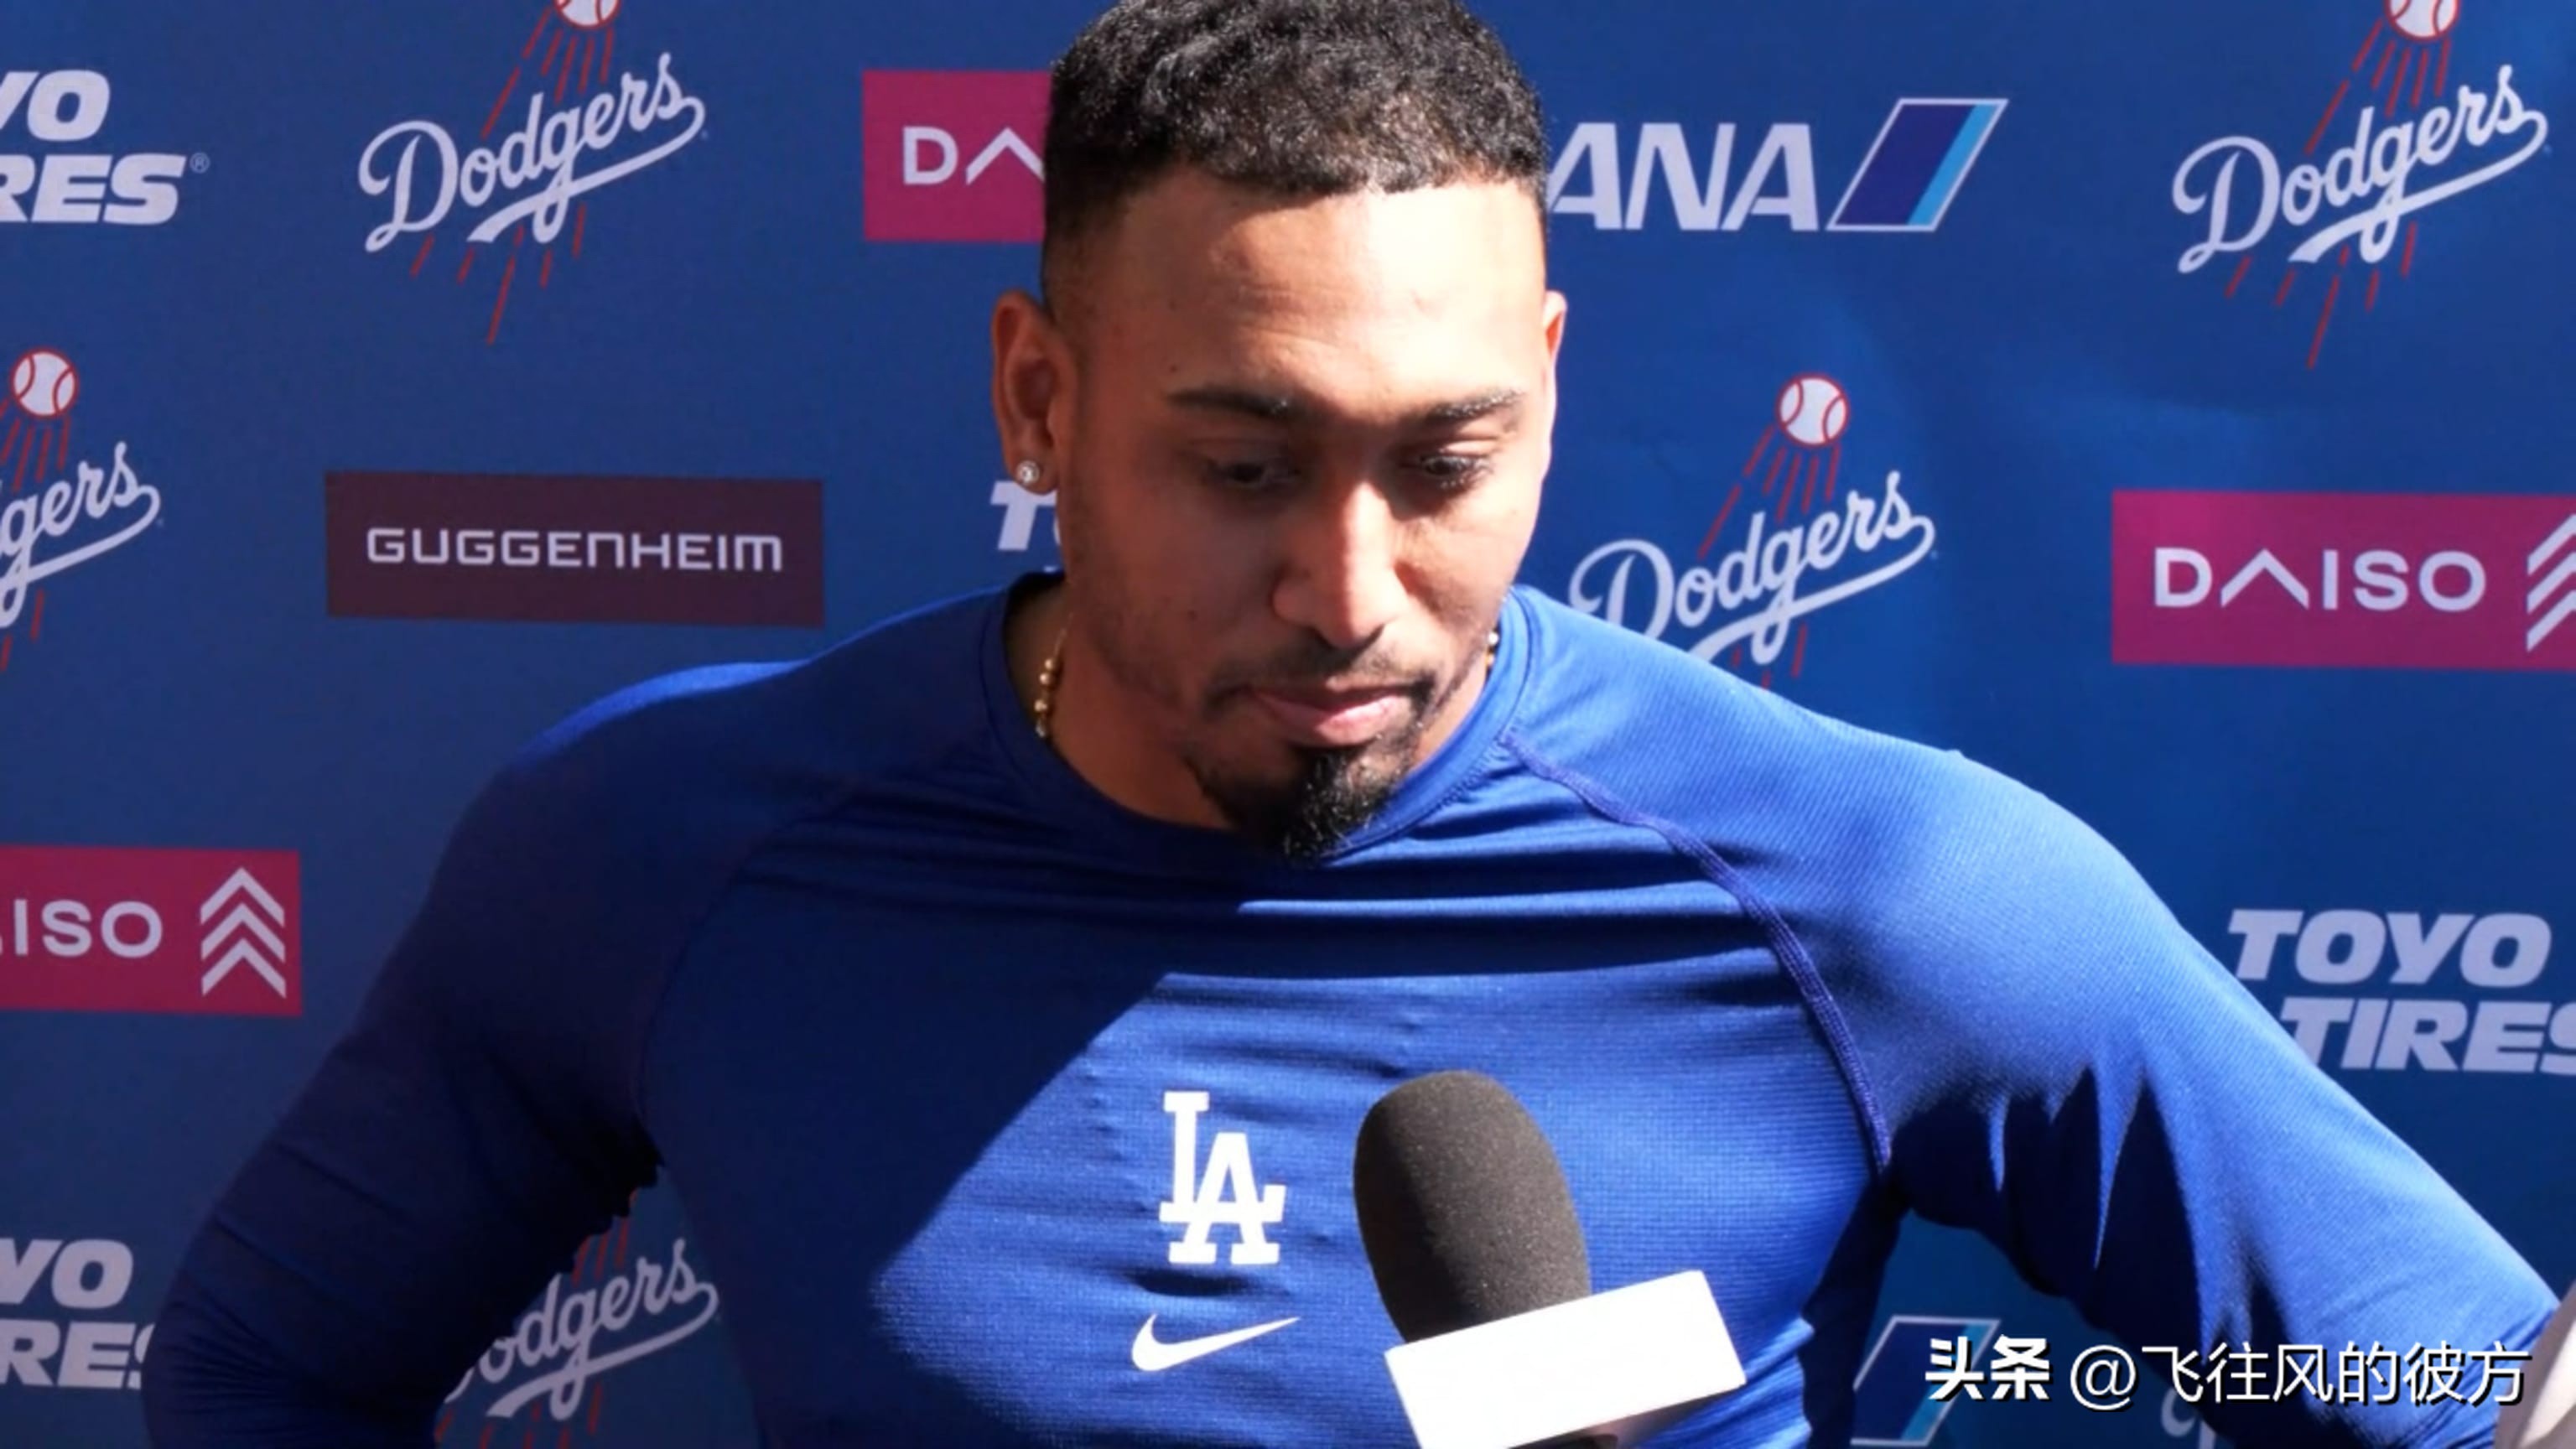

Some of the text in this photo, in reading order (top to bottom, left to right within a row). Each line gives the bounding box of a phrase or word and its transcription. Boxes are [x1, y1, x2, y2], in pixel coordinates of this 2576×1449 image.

[358, 52, 705, 252] Dodgers
[1548, 122, 1819, 231] ANA
[2173, 64, 2548, 273] Dodgers
[366, 527, 782, 571] GUGGENHEIM
[1568, 470, 1935, 664] Dodgers
[2154, 547, 2485, 612] DAISO
[0, 899, 164, 958] ISO
[2228, 909, 2552, 987] TOYO
[1159, 1092, 1286, 1265] LA
[444, 1238, 720, 1420] odgers
